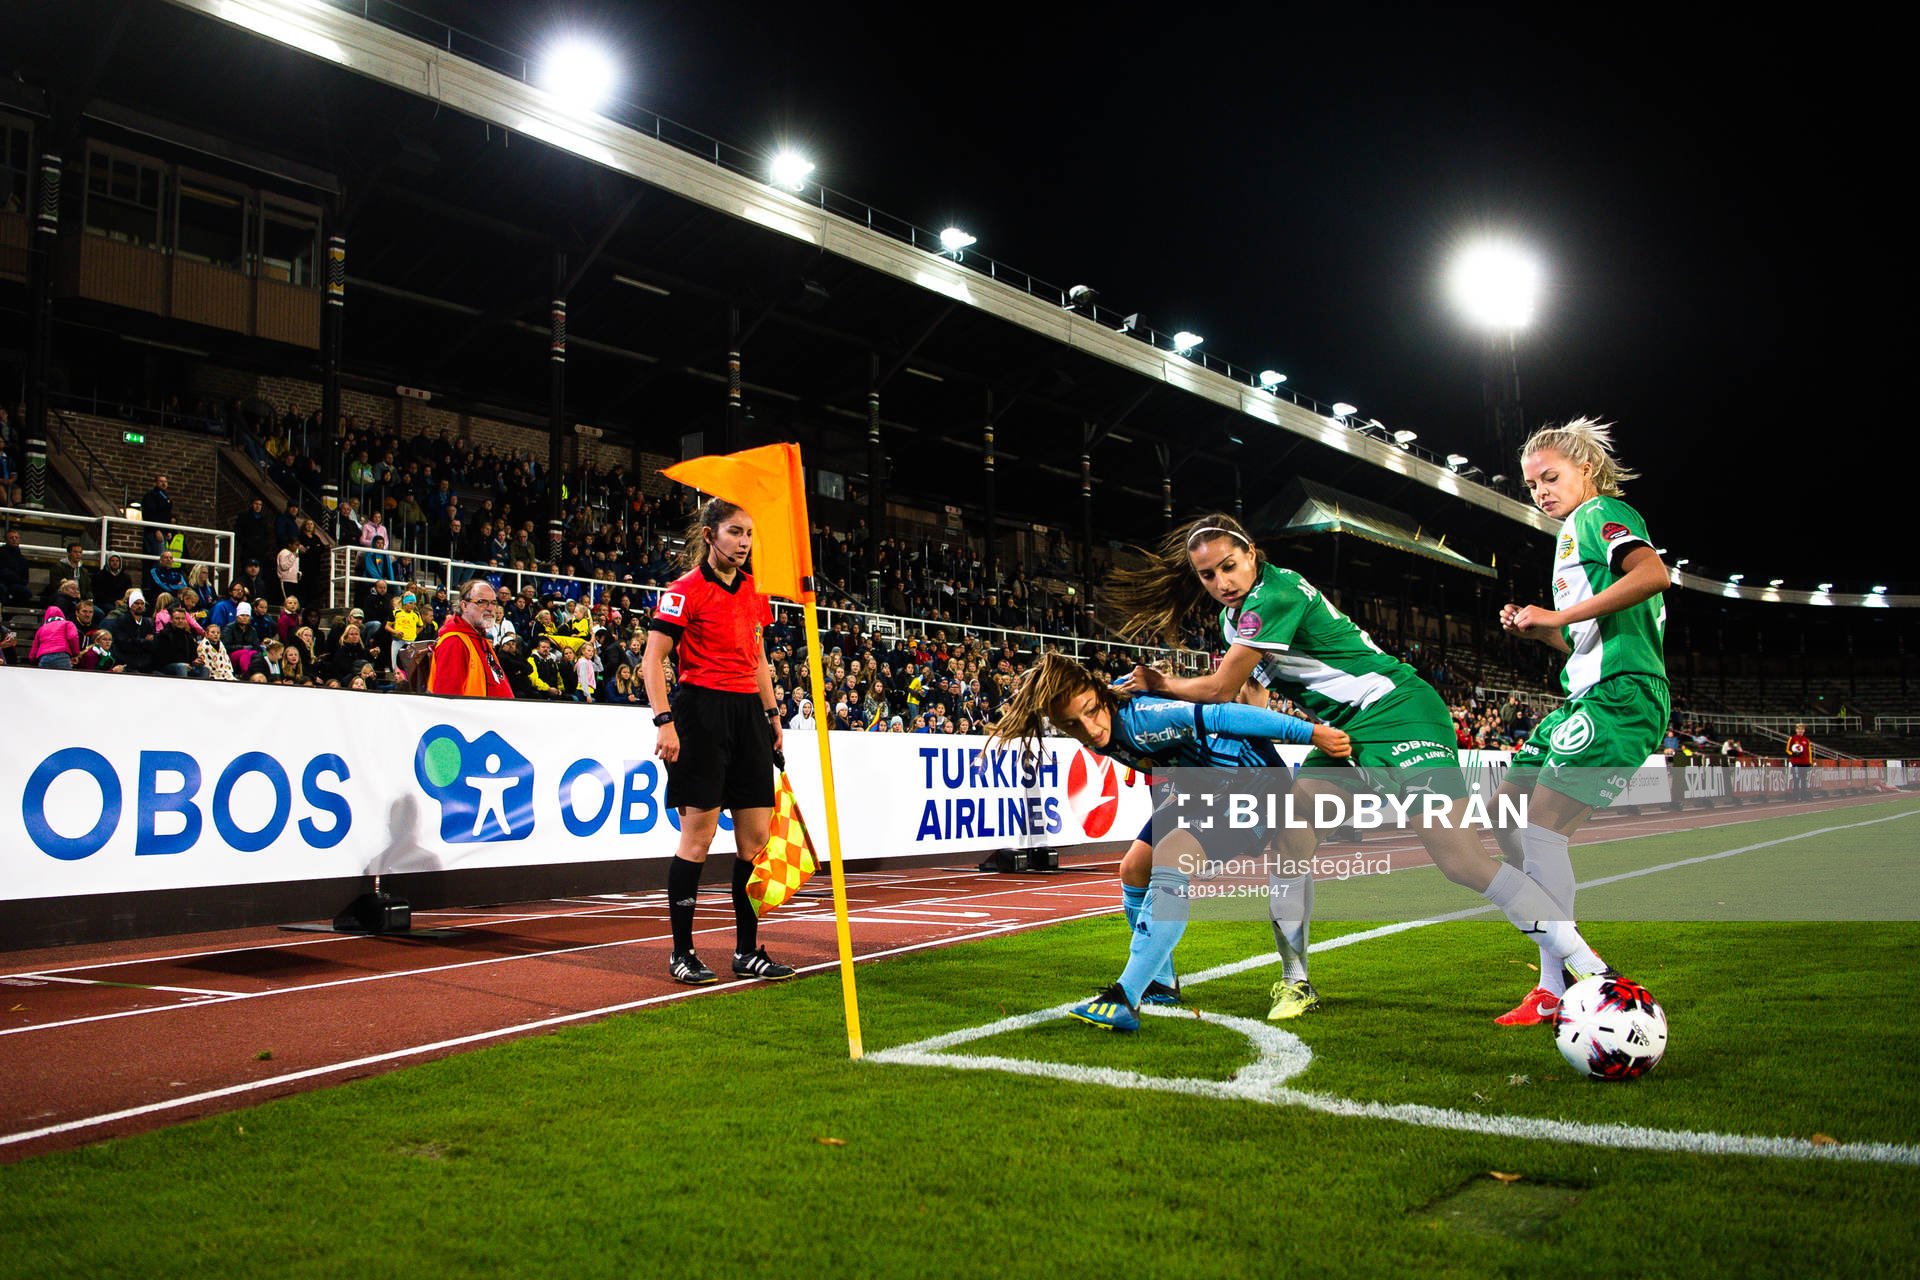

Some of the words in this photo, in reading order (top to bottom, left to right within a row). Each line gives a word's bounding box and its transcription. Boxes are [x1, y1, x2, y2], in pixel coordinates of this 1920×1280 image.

[1134, 726, 1196, 745] stadium
[919, 748, 1058, 789] TURKISH
[22, 747, 352, 860] OBOS
[558, 758, 735, 838] OB
[916, 797, 1062, 841] AIRLINES
